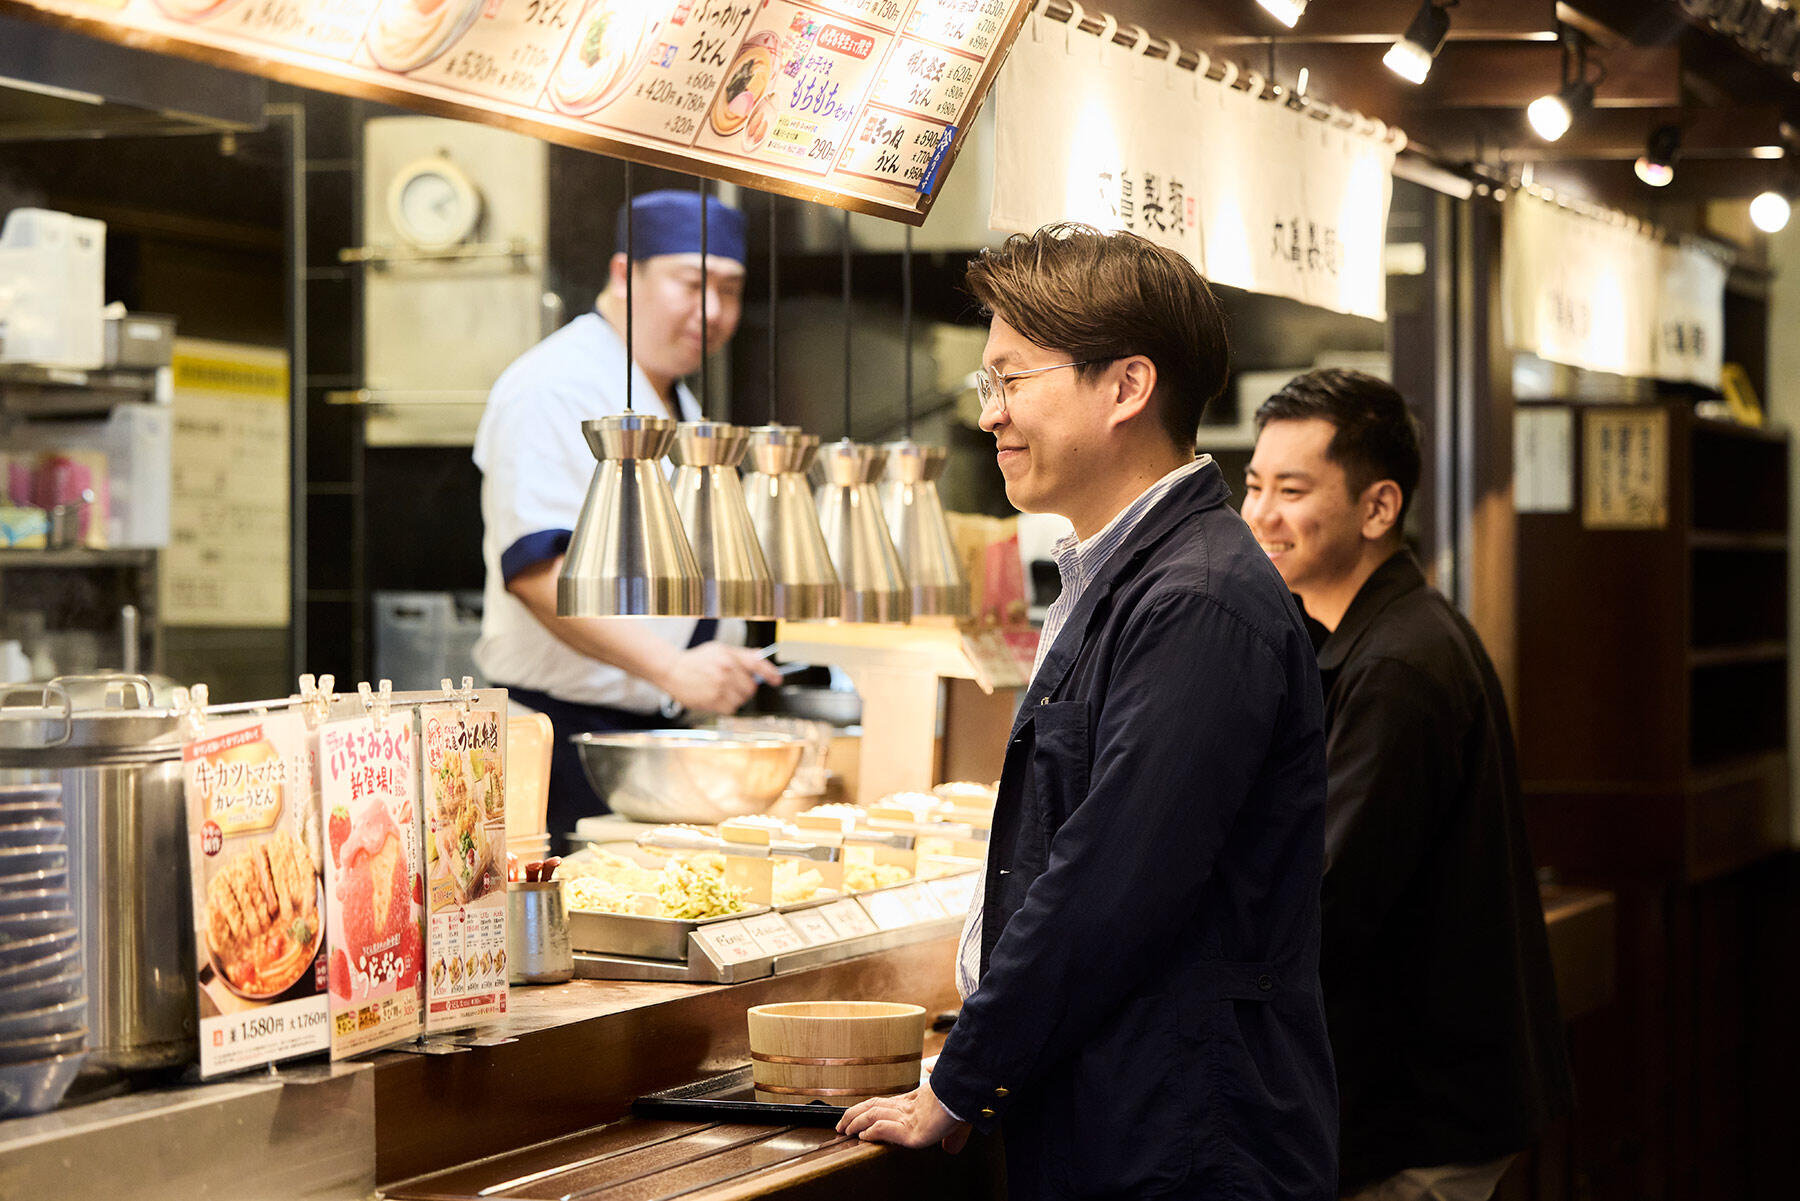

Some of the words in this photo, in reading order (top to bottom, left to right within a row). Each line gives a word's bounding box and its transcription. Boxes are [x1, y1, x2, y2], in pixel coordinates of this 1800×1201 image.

[689, 31, 727, 67] うどん
[908, 84, 932, 107] うどん
[871, 118, 905, 150] きつね
[808, 138, 836, 160] 290円
[875, 150, 901, 174] うどん
[331, 727, 403, 782] いちごみるく
[195, 760, 287, 793] 牛カツトマたま
[216, 788, 275, 810] カレーうどん
